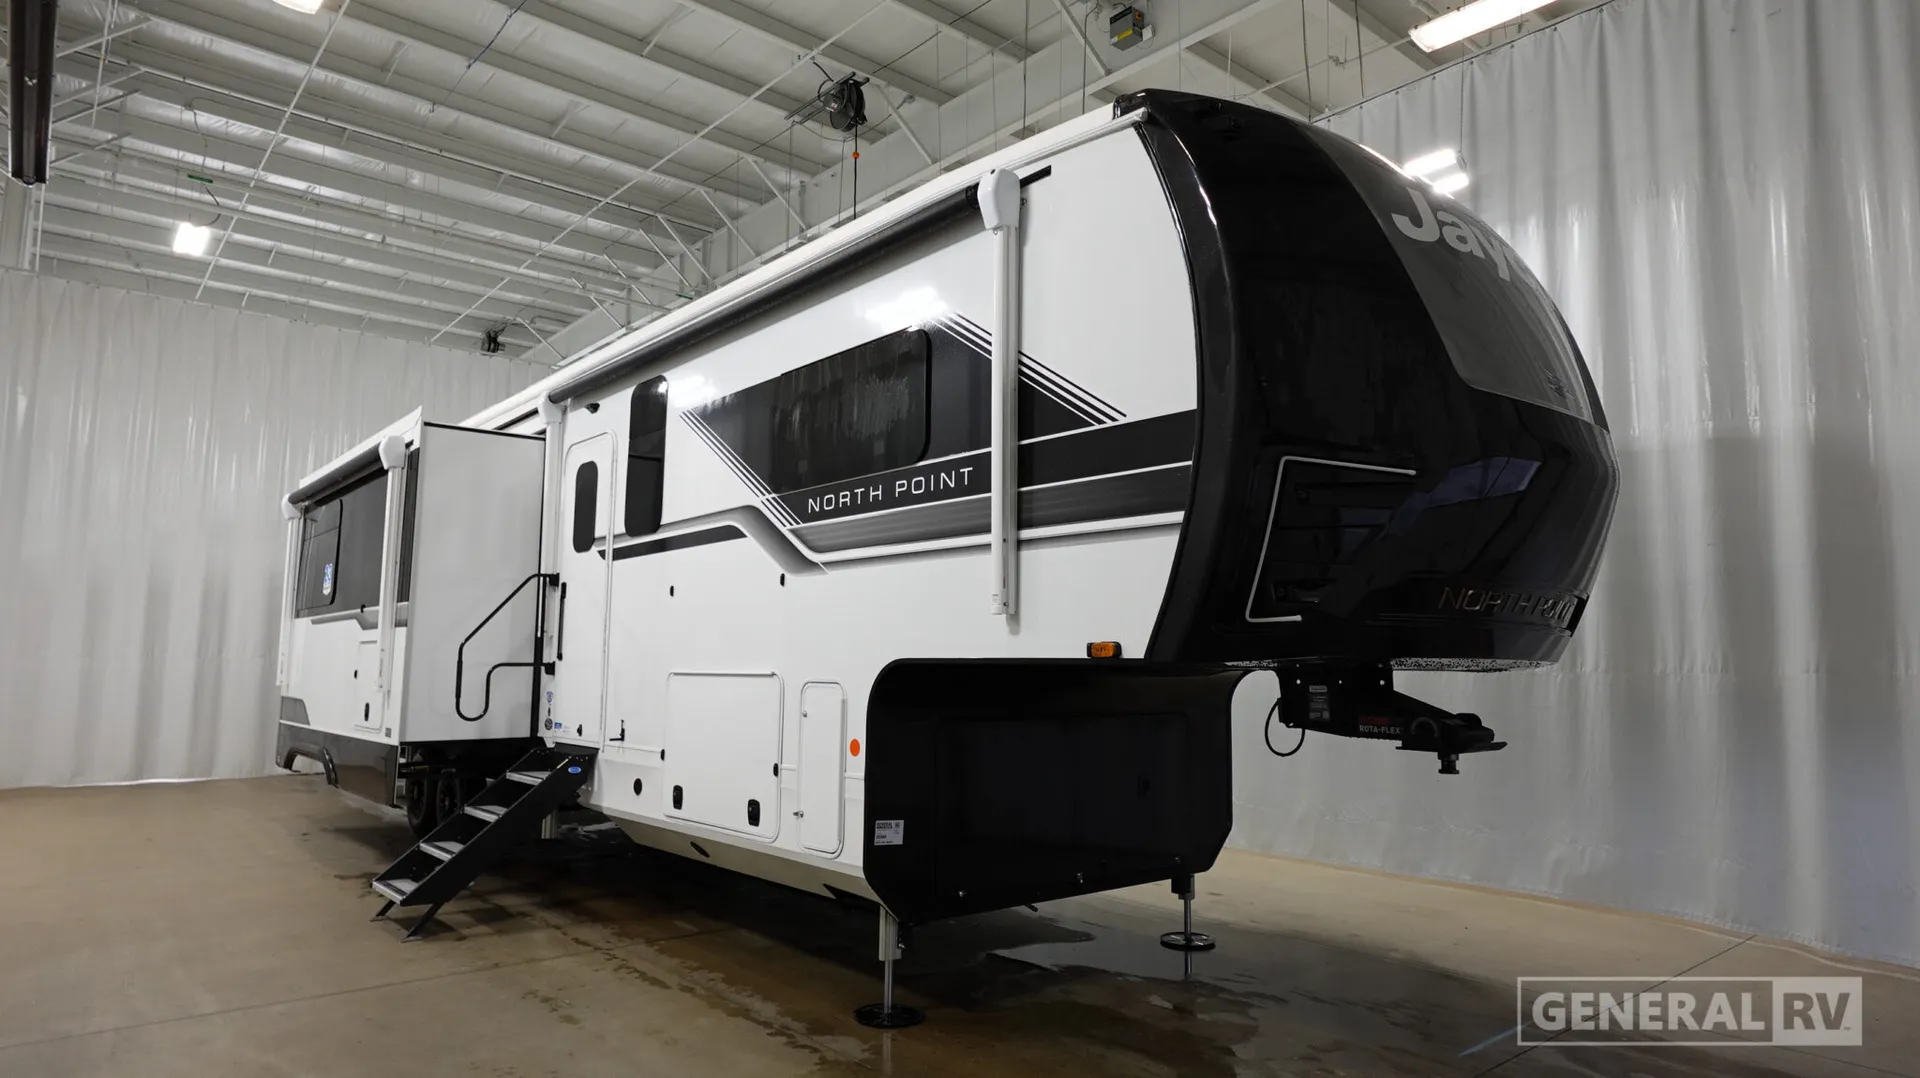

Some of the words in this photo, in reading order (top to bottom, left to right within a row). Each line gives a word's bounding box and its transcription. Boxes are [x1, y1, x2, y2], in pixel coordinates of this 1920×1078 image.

[807, 484, 883, 514] NORTH
[895, 466, 974, 498] POINT
[1437, 586, 1532, 615] NORTH
[1359, 724, 1401, 735] ROTA-FLEX
